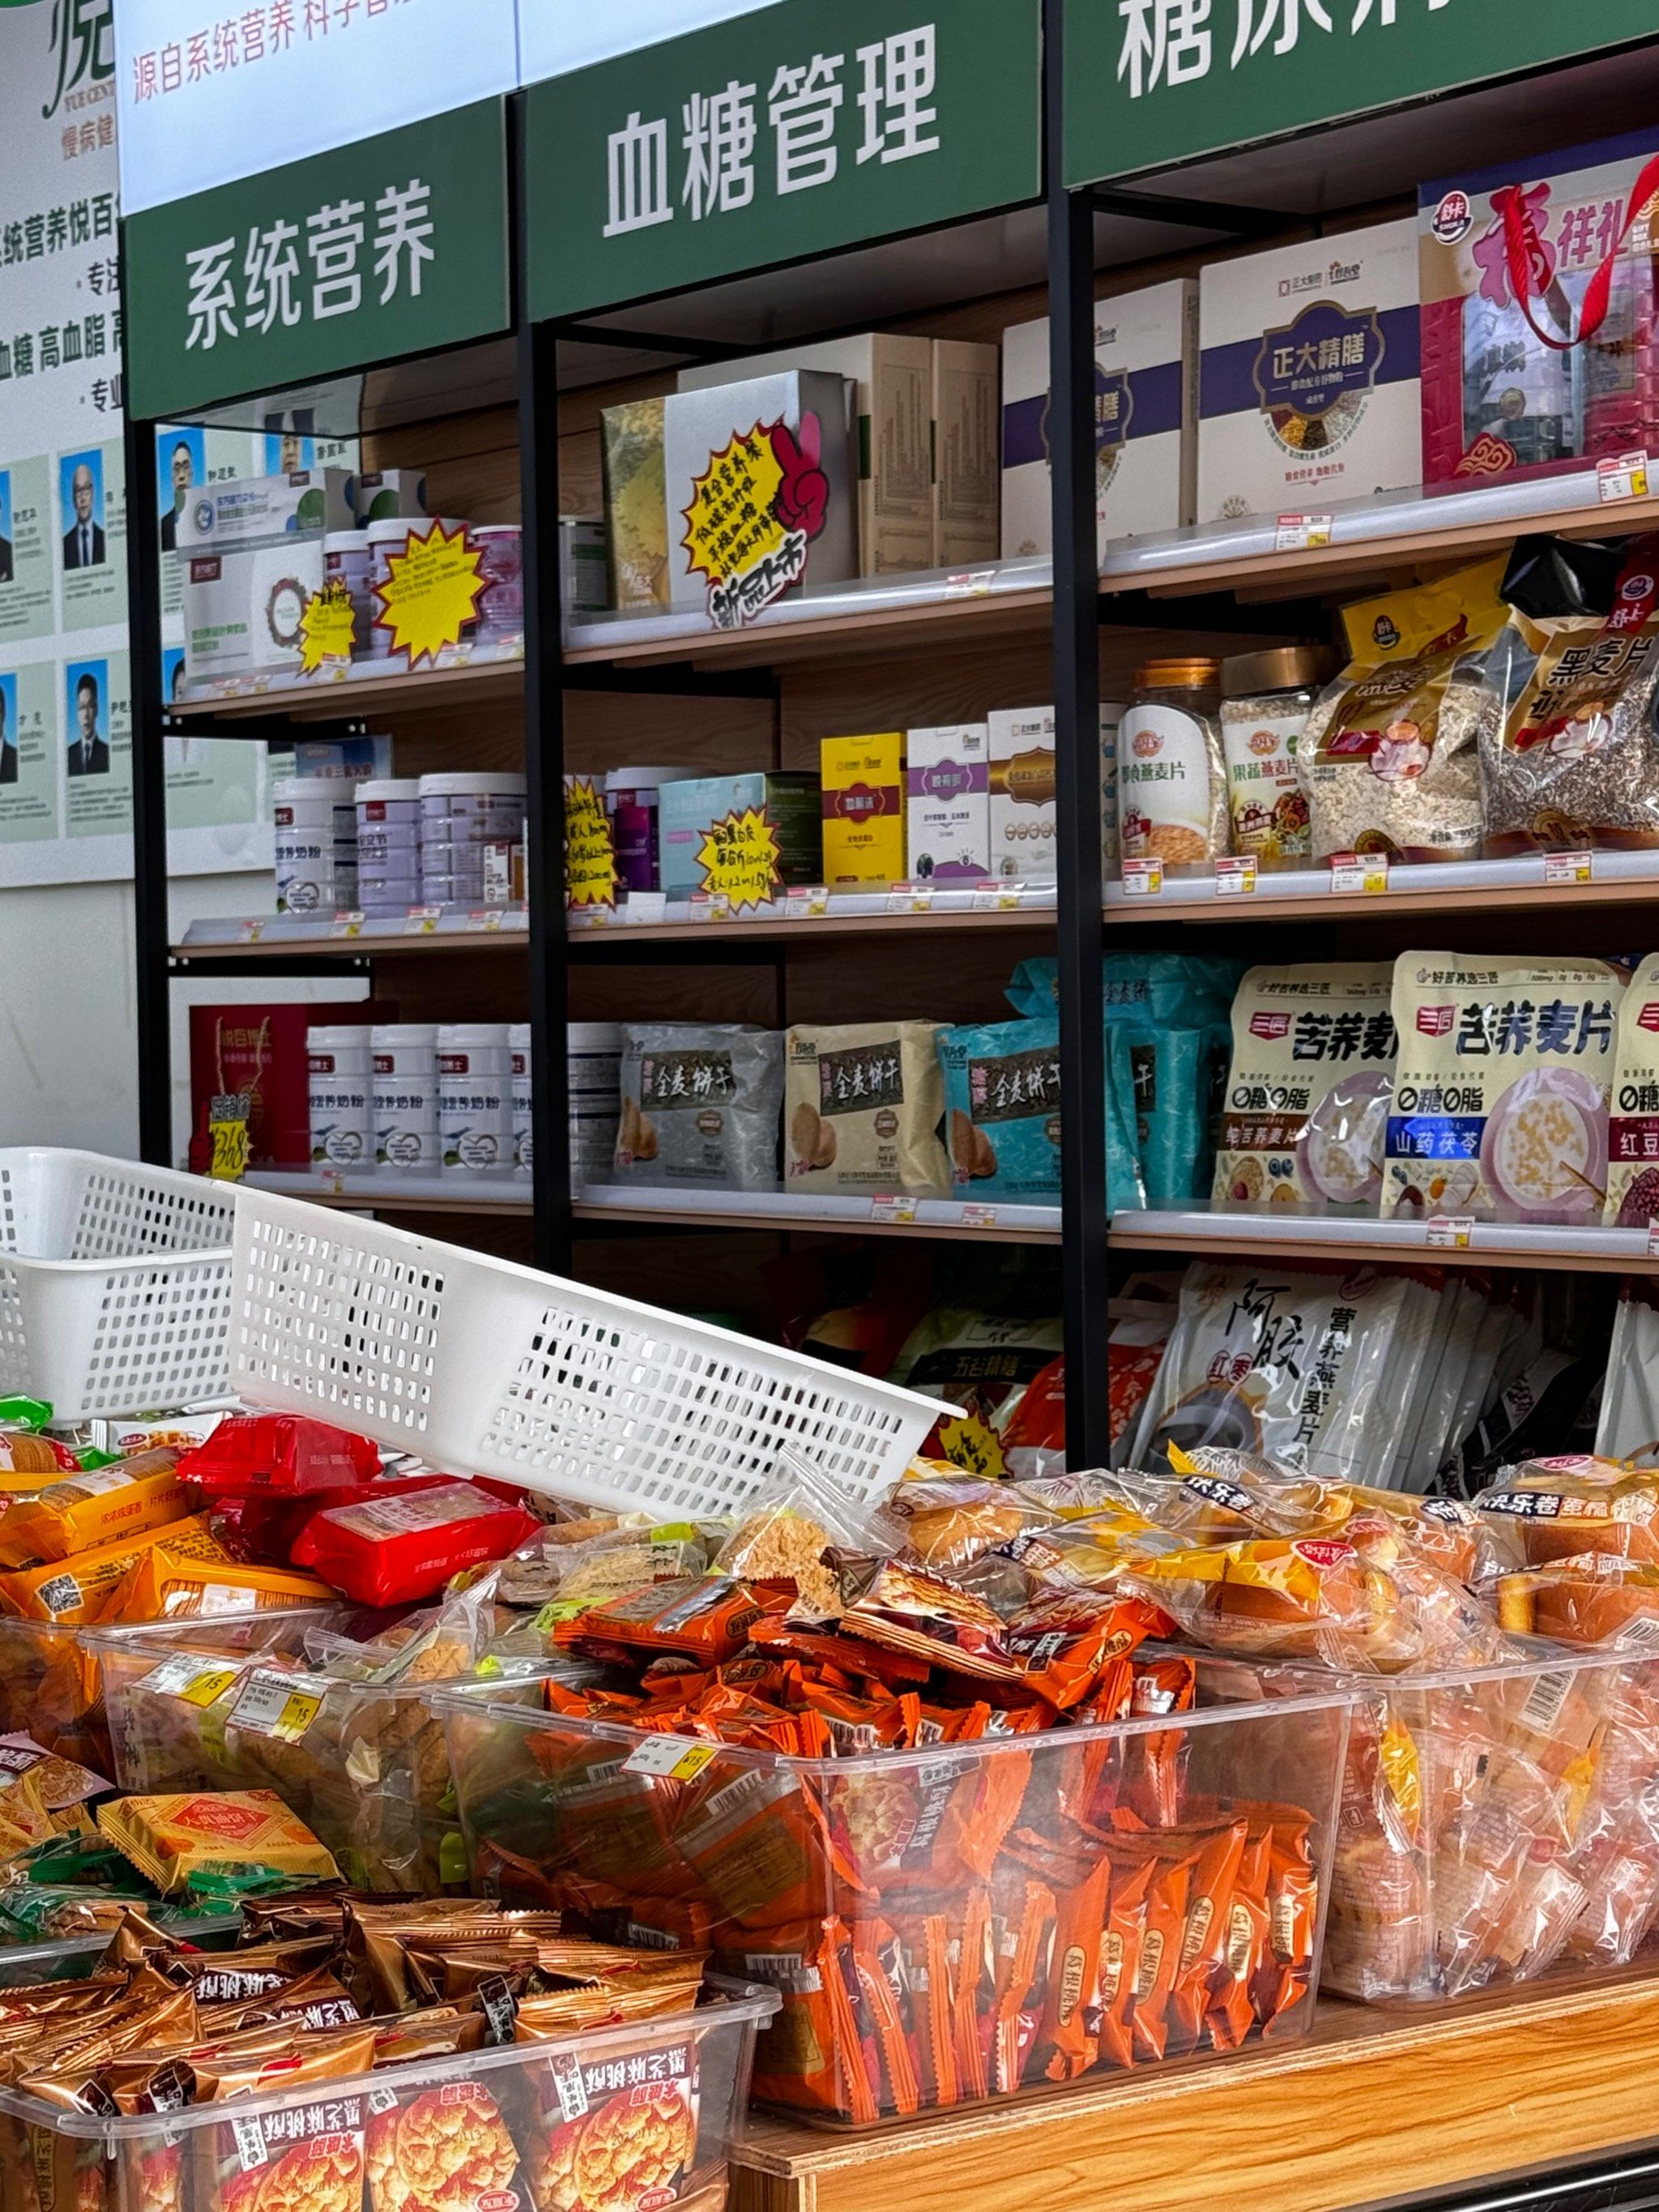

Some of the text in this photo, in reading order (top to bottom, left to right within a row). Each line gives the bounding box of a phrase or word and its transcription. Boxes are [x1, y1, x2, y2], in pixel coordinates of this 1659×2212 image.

[133, 1, 295, 105] 源自系统营养
[603, 23, 940, 238] 血糖管理
[0, 192, 120, 267] 统营养悦百
[185, 179, 434, 350] 系统营养
[1293, 1010, 1398, 1061] 苦荞麦
[1456, 998, 1616, 1056] 苦荞麦片
[655, 1065, 732, 1097] 全麦饼干
[834, 1058, 901, 1099] 全麦饼干
[991, 1063, 1061, 1108] 全麦饼干
[1397, 1084, 1484, 1113] 0糖0脂
[1396, 1131, 1478, 1155] 山药茯苓
[1225, 1277, 1305, 1381] 阿胶
[1483, 1493, 1560, 1516] 快乐卷
[205, 1676, 224, 1691] 15
[295, 1707, 309, 1723] 15
[586, 2047, 689, 2095] 黑芝麻桃酥
[263, 2096, 362, 2142] 黑芝麻桃酥
